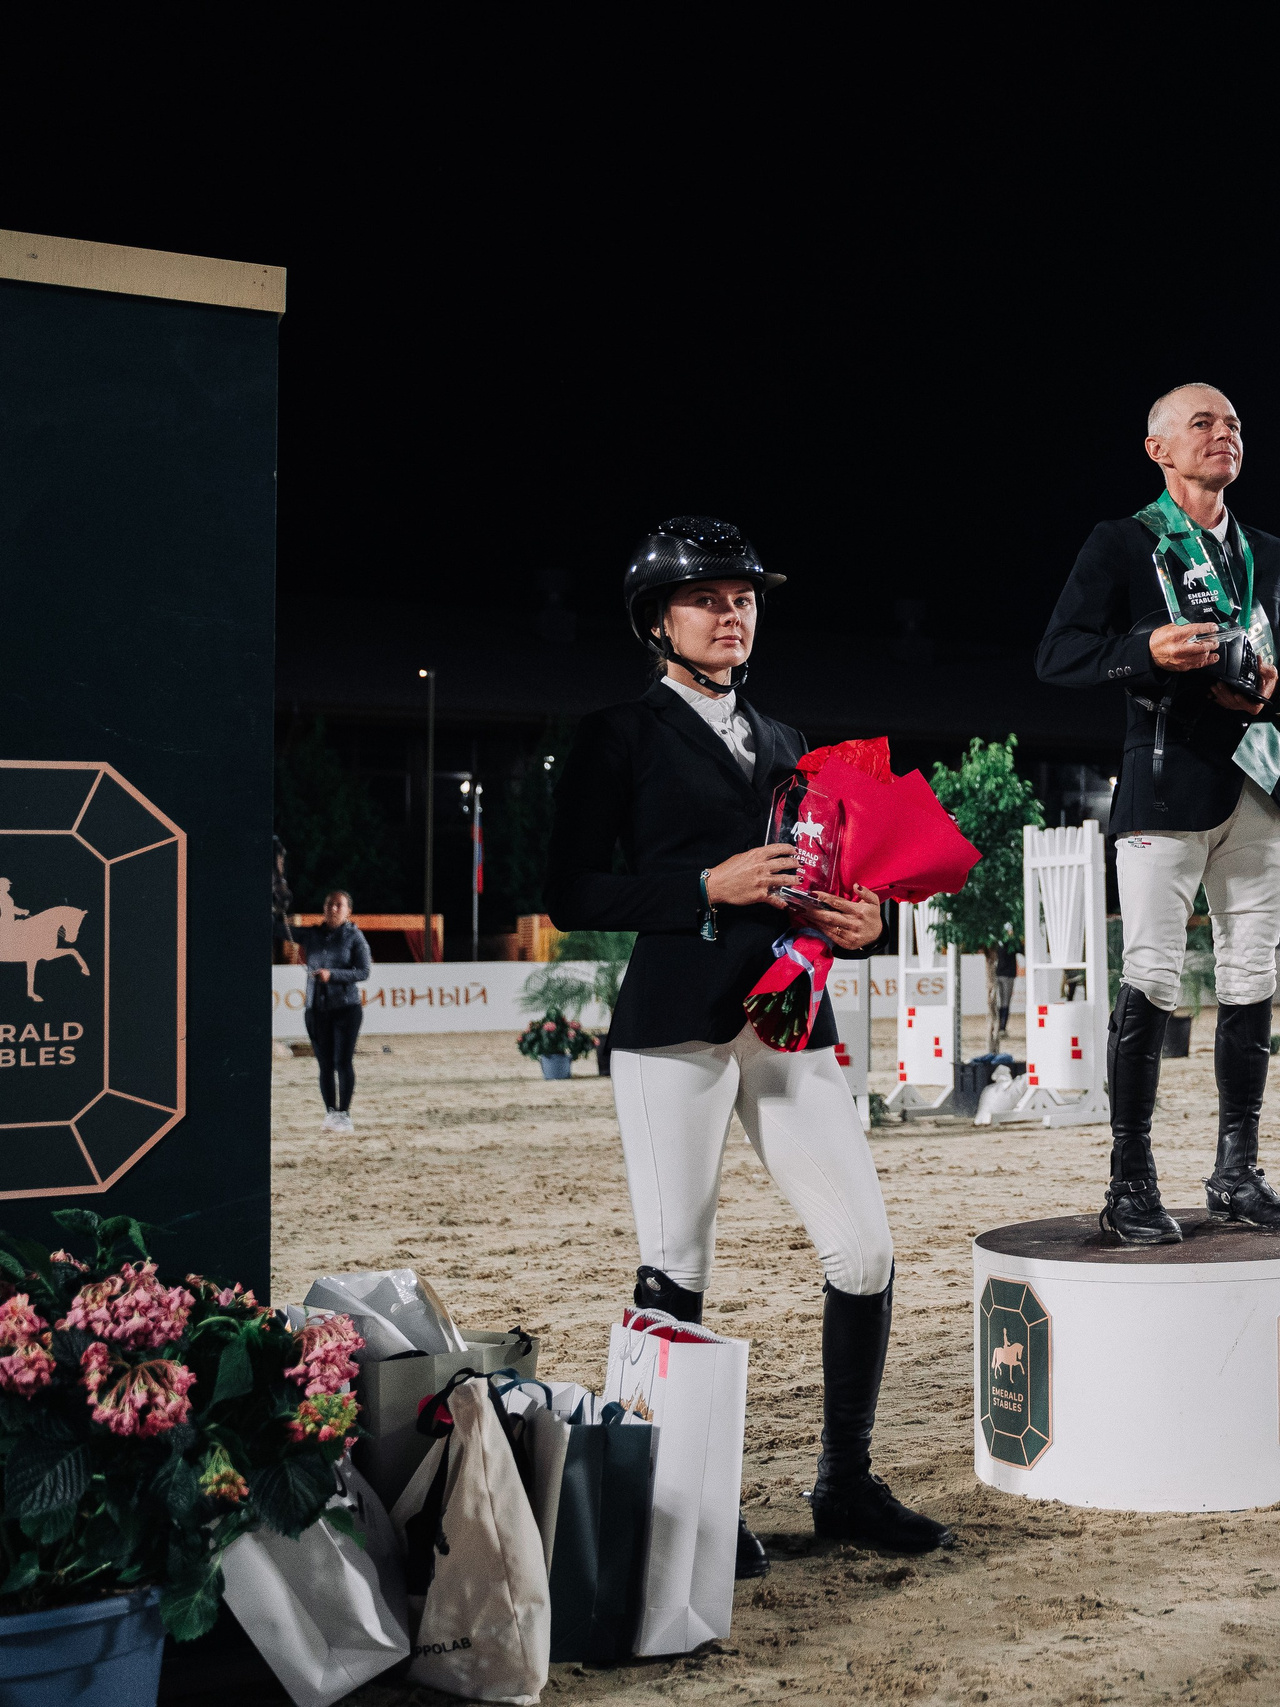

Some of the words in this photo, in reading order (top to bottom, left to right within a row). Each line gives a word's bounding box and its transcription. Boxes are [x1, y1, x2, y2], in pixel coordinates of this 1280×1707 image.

[833, 977, 945, 998] STABES
[991, 1386, 1024, 1403] EMERALD
[992, 1397, 1022, 1413] STABLES
